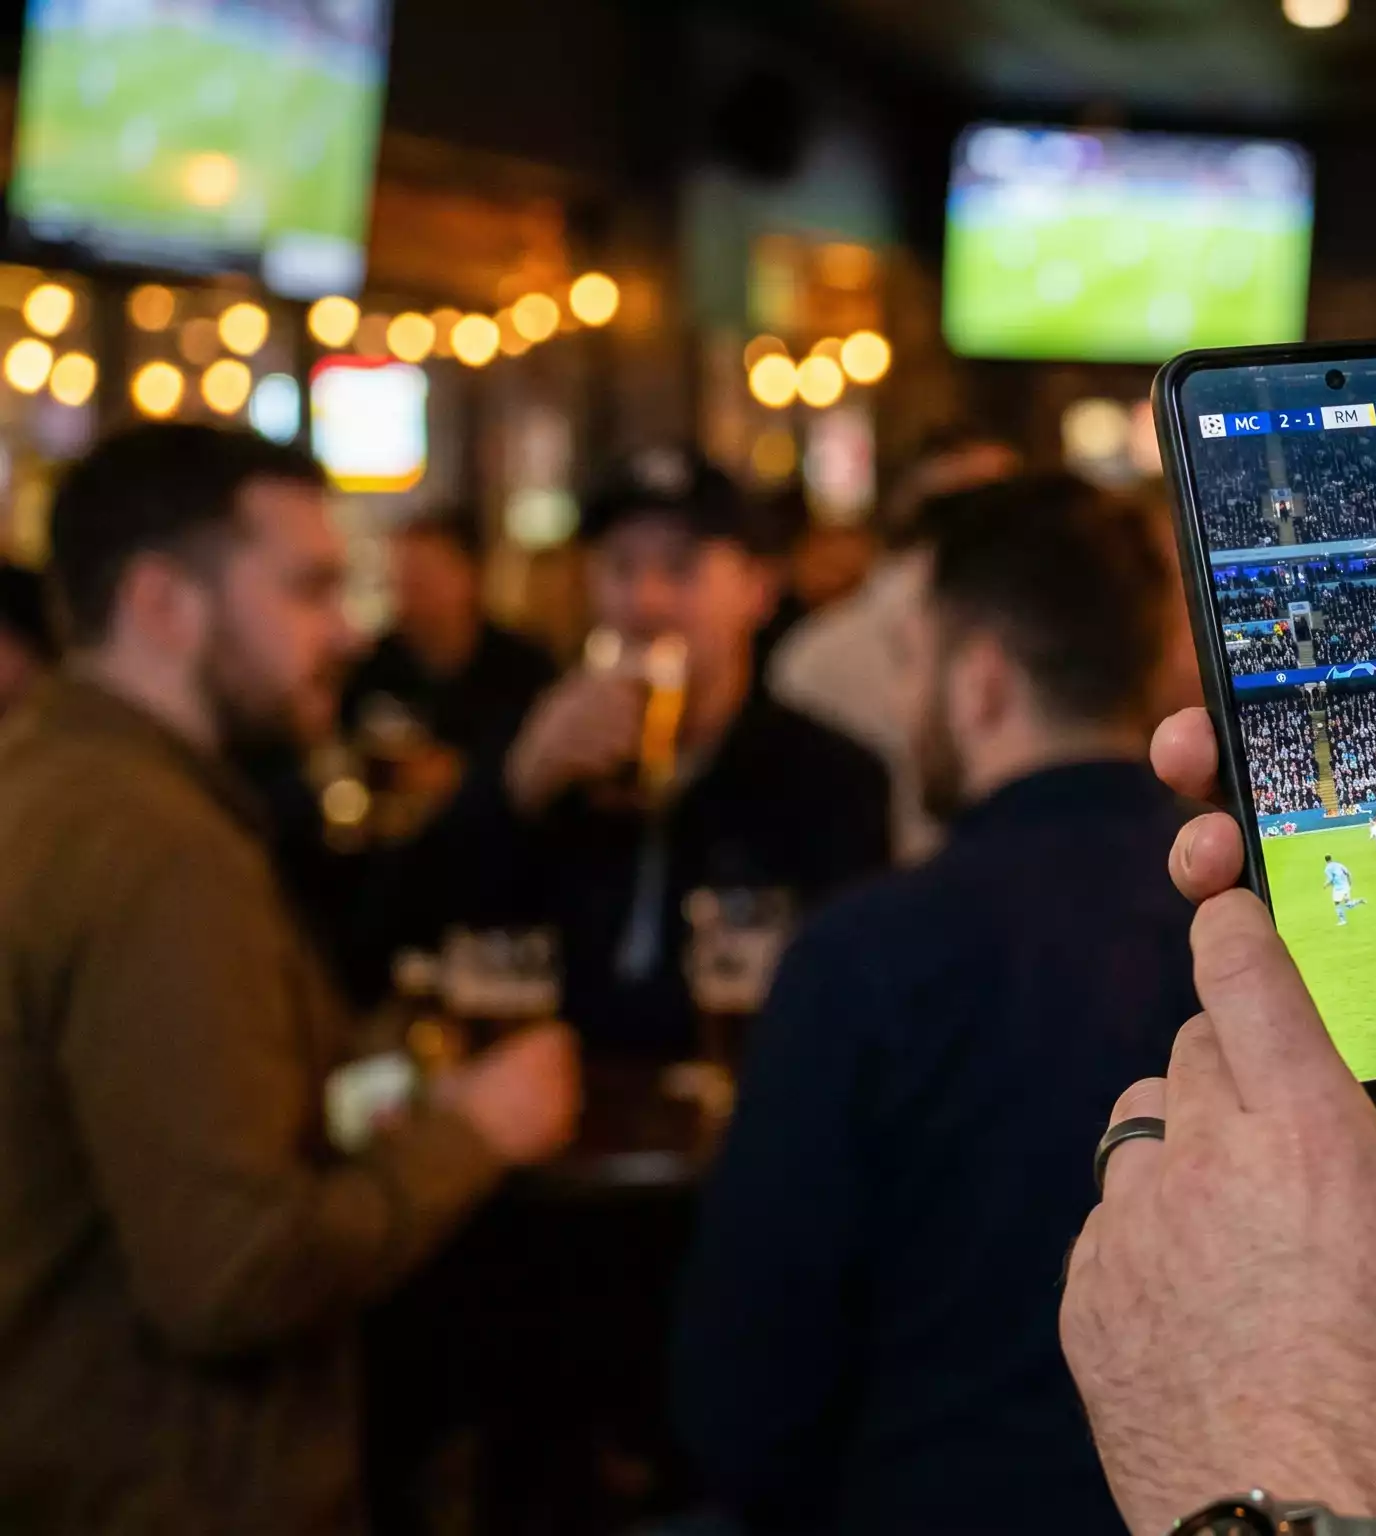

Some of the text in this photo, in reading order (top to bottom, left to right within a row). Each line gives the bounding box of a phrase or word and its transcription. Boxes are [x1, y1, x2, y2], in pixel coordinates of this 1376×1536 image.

[1235, 415, 1260, 431] MC
[1279, 413, 1290, 428] 2
[1306, 412, 1315, 426] 1
[1334, 409, 1358, 423] RM
